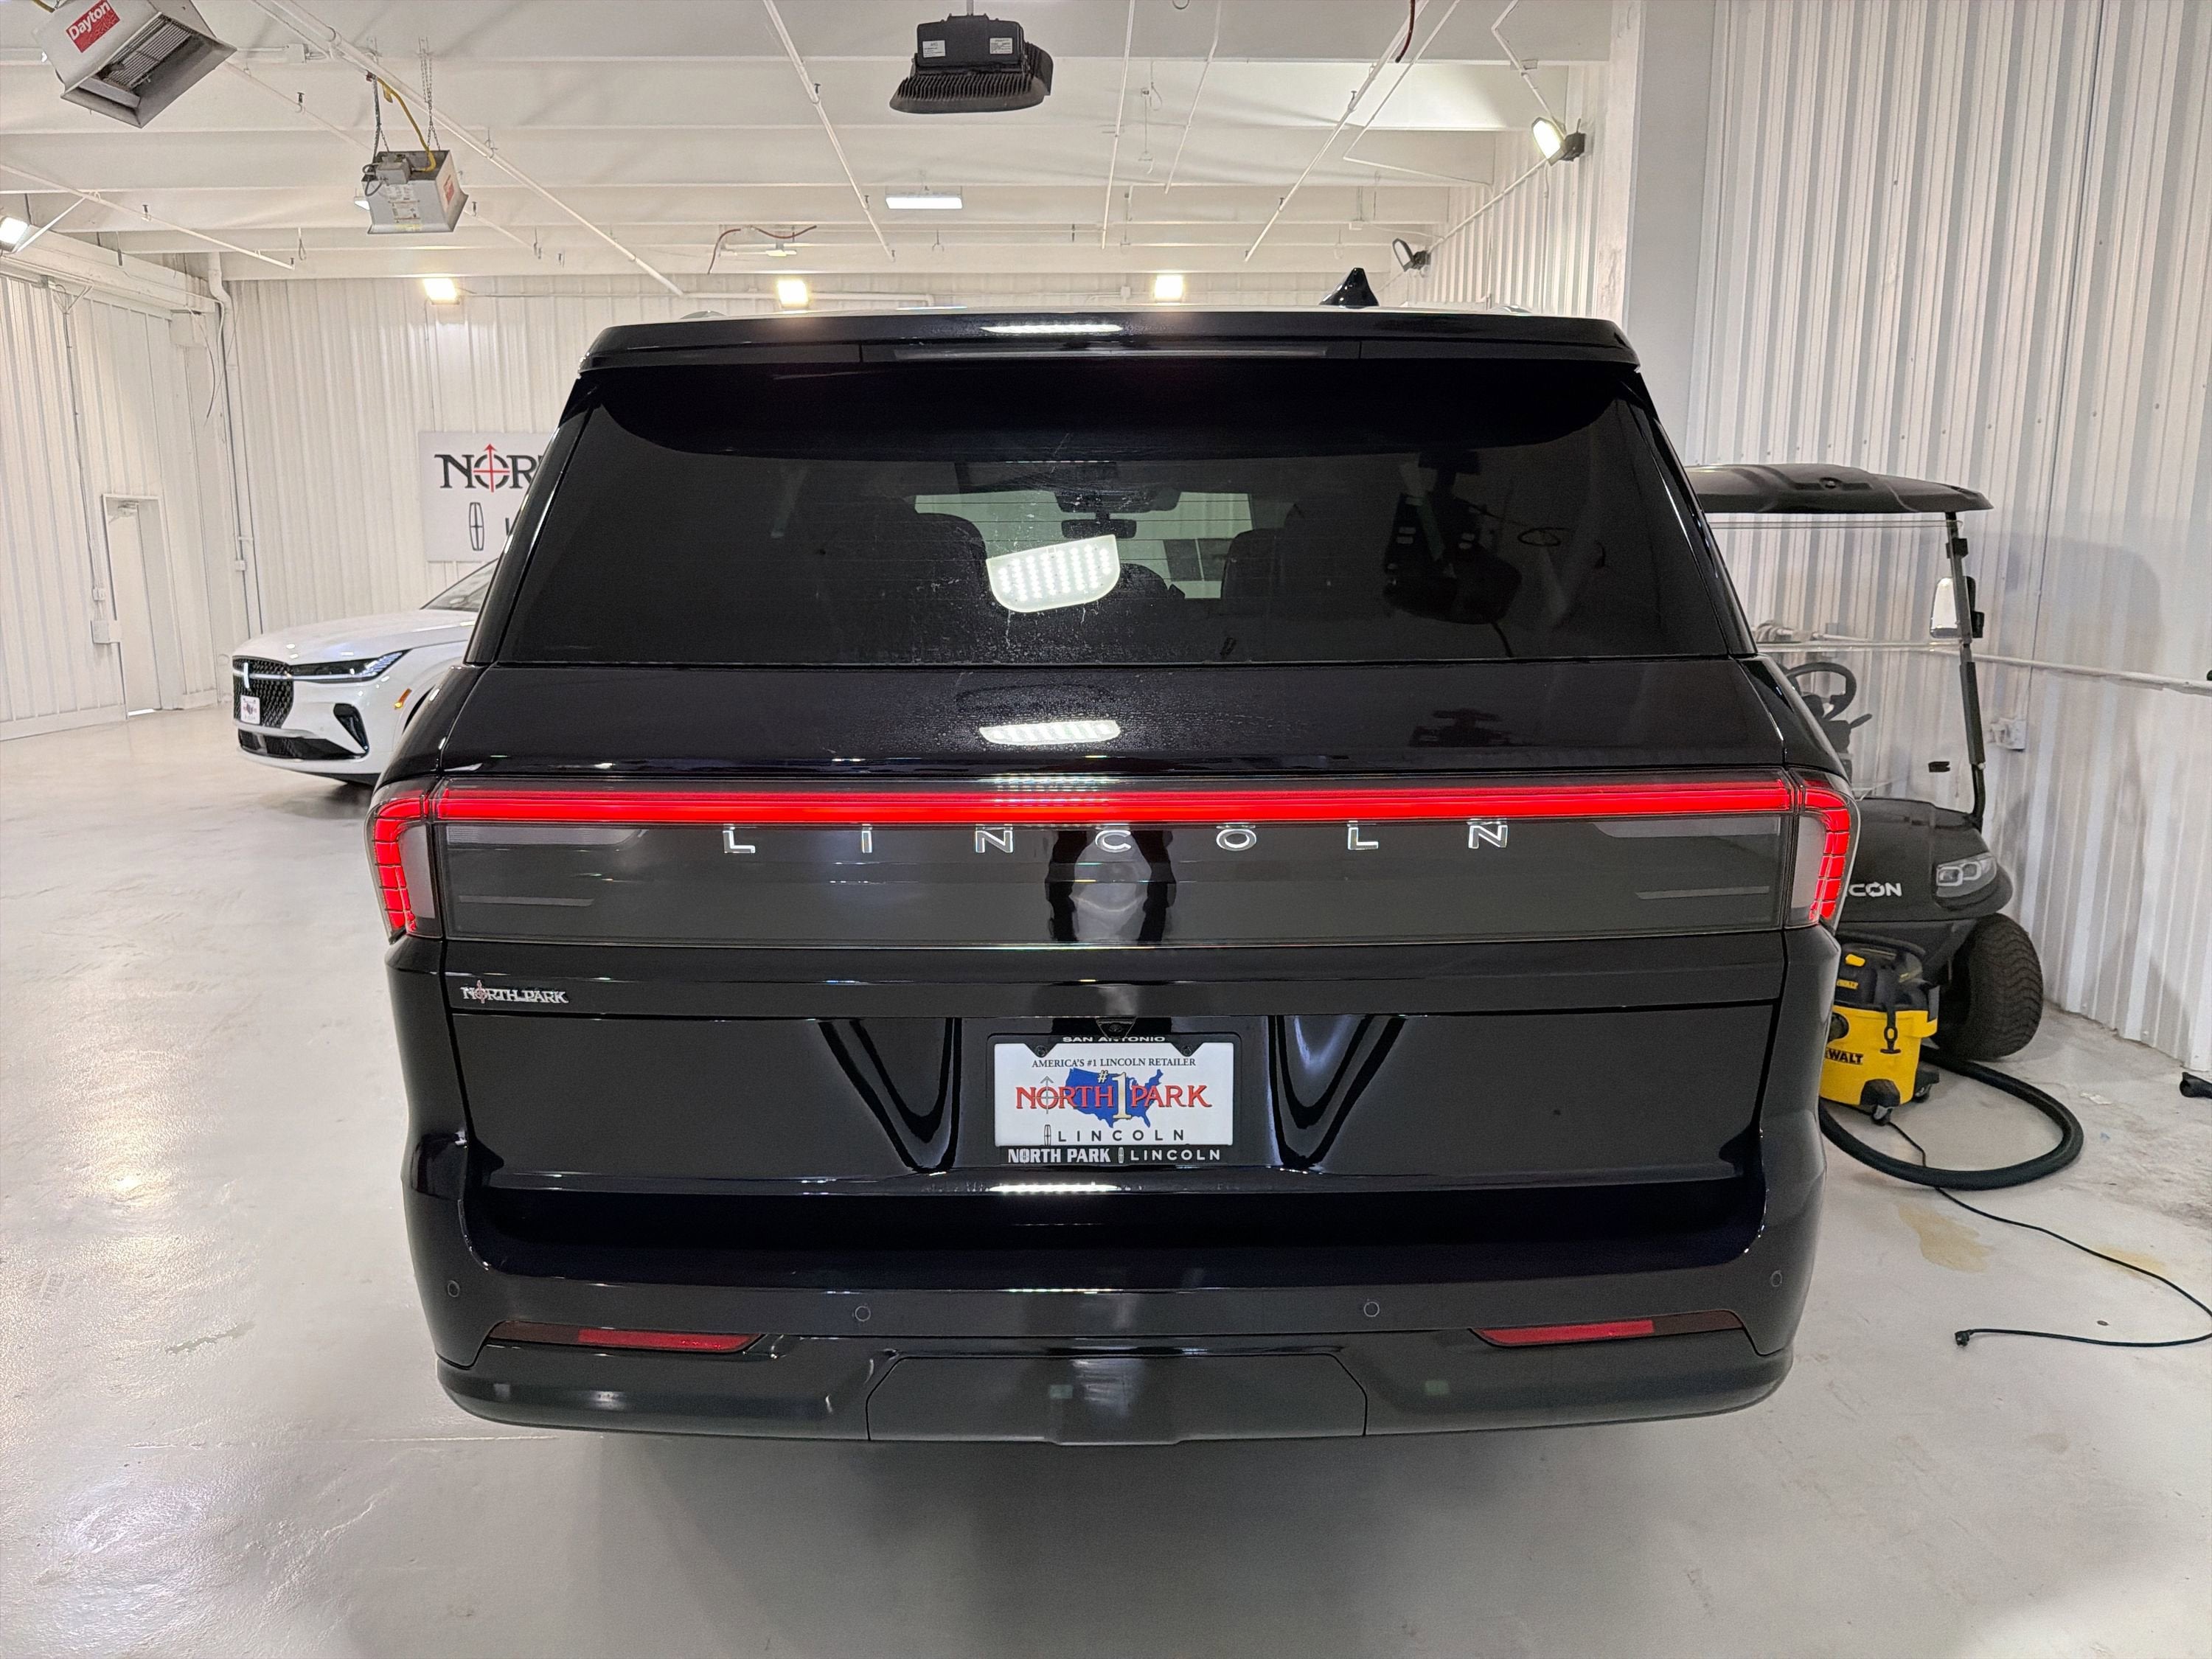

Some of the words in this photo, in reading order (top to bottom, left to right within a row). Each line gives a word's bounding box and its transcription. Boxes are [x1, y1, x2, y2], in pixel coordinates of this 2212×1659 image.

[68, 2, 111, 41] Dayton
[434, 453, 543, 489] NOR
[723, 824, 1509, 854] LINCOLN
[1846, 881, 1902, 897] CON
[460, 985, 518, 1002] NORTH
[521, 989, 569, 1004] PARK
[1032, 1059, 1085, 1068] AMERICA'S
[1099, 1058, 1146, 1066] LINCOLN
[1148, 1058, 1196, 1066] RETAILER
[1015, 1085, 1114, 1110] NORTH
[1130, 1085, 1213, 1107] PARK
[1058, 1130, 1183, 1142] LINCOLN
[1008, 1148, 1061, 1164] NORTH
[1067, 1148, 1111, 1163] PARK
[1130, 1150, 1220, 1161] LINCOLN
